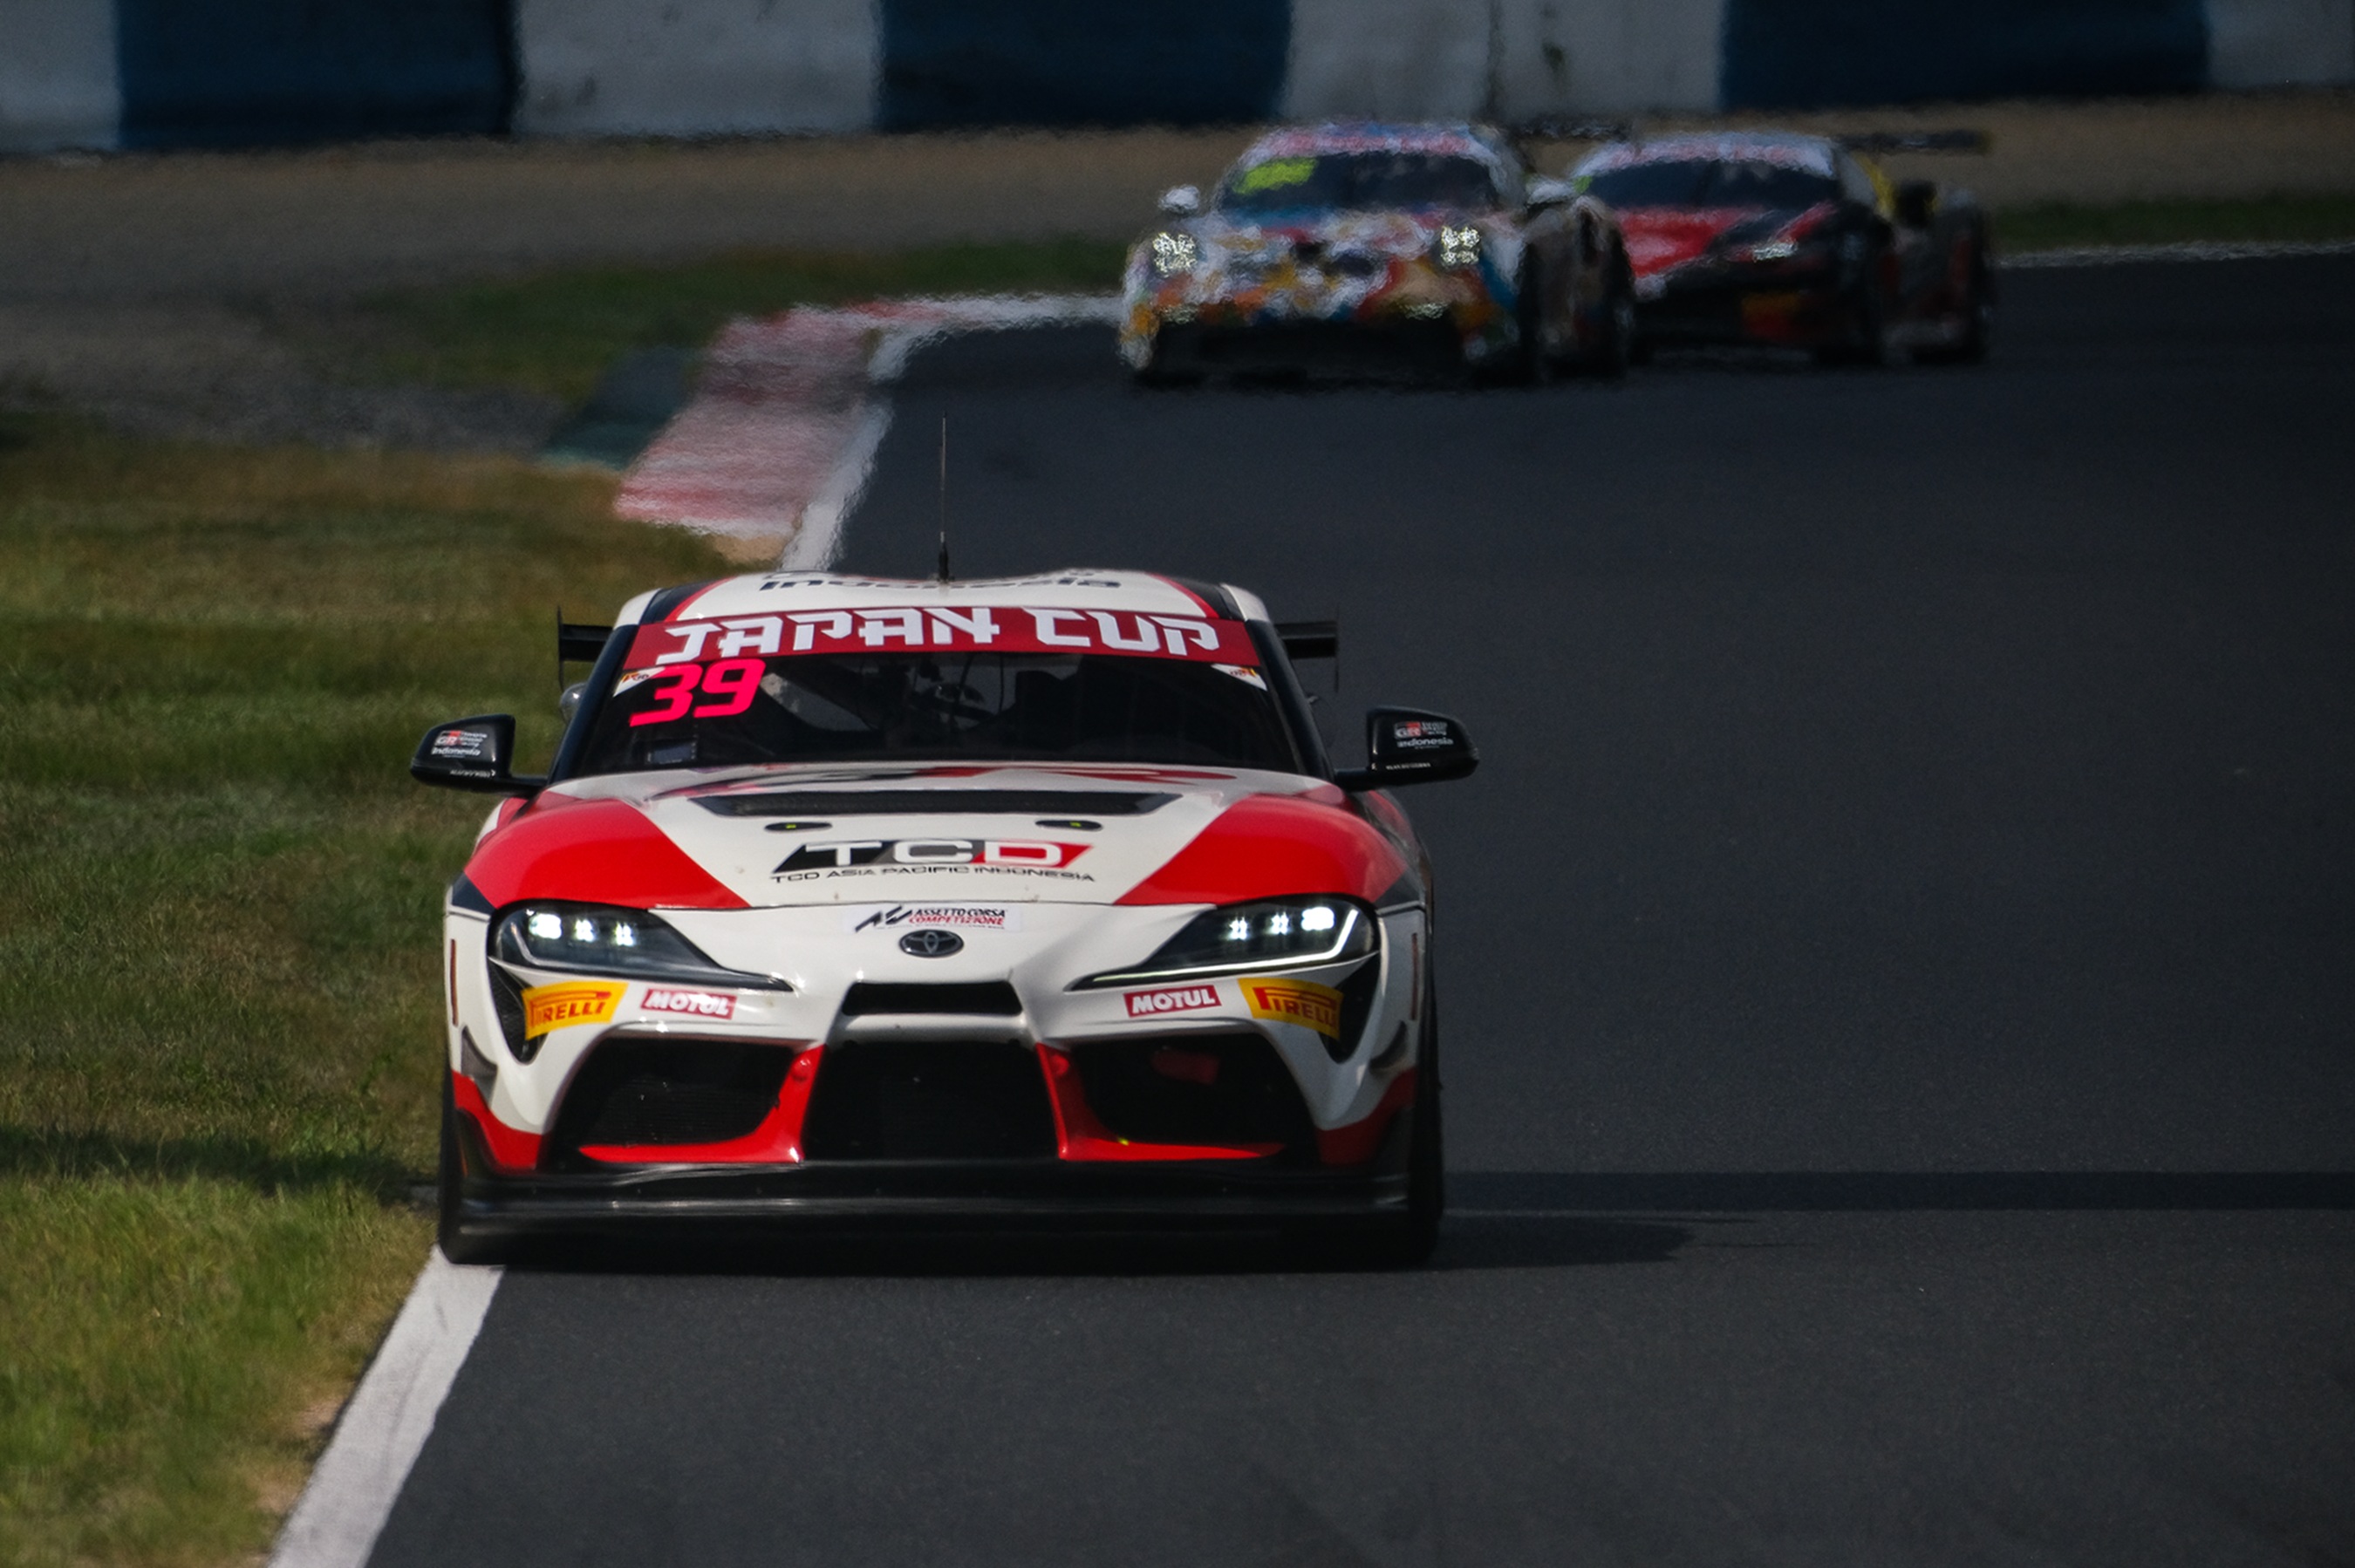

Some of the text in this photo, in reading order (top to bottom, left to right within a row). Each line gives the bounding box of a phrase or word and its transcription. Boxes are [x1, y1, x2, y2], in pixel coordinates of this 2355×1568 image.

[655, 608, 1220, 665] JAPAN CUP
[628, 658, 767, 727] 39
[804, 840, 1063, 867] TCD
[771, 866, 1096, 883] TCD ASIA PACIFIC INDONESIA
[915, 908, 1006, 917] ASSETTO CORSA
[529, 991, 611, 1028] PIRELLI
[646, 989, 730, 1016] MOTUL
[1131, 988, 1215, 1014] MOTUL
[1253, 986, 1338, 1028] PIRELLI
